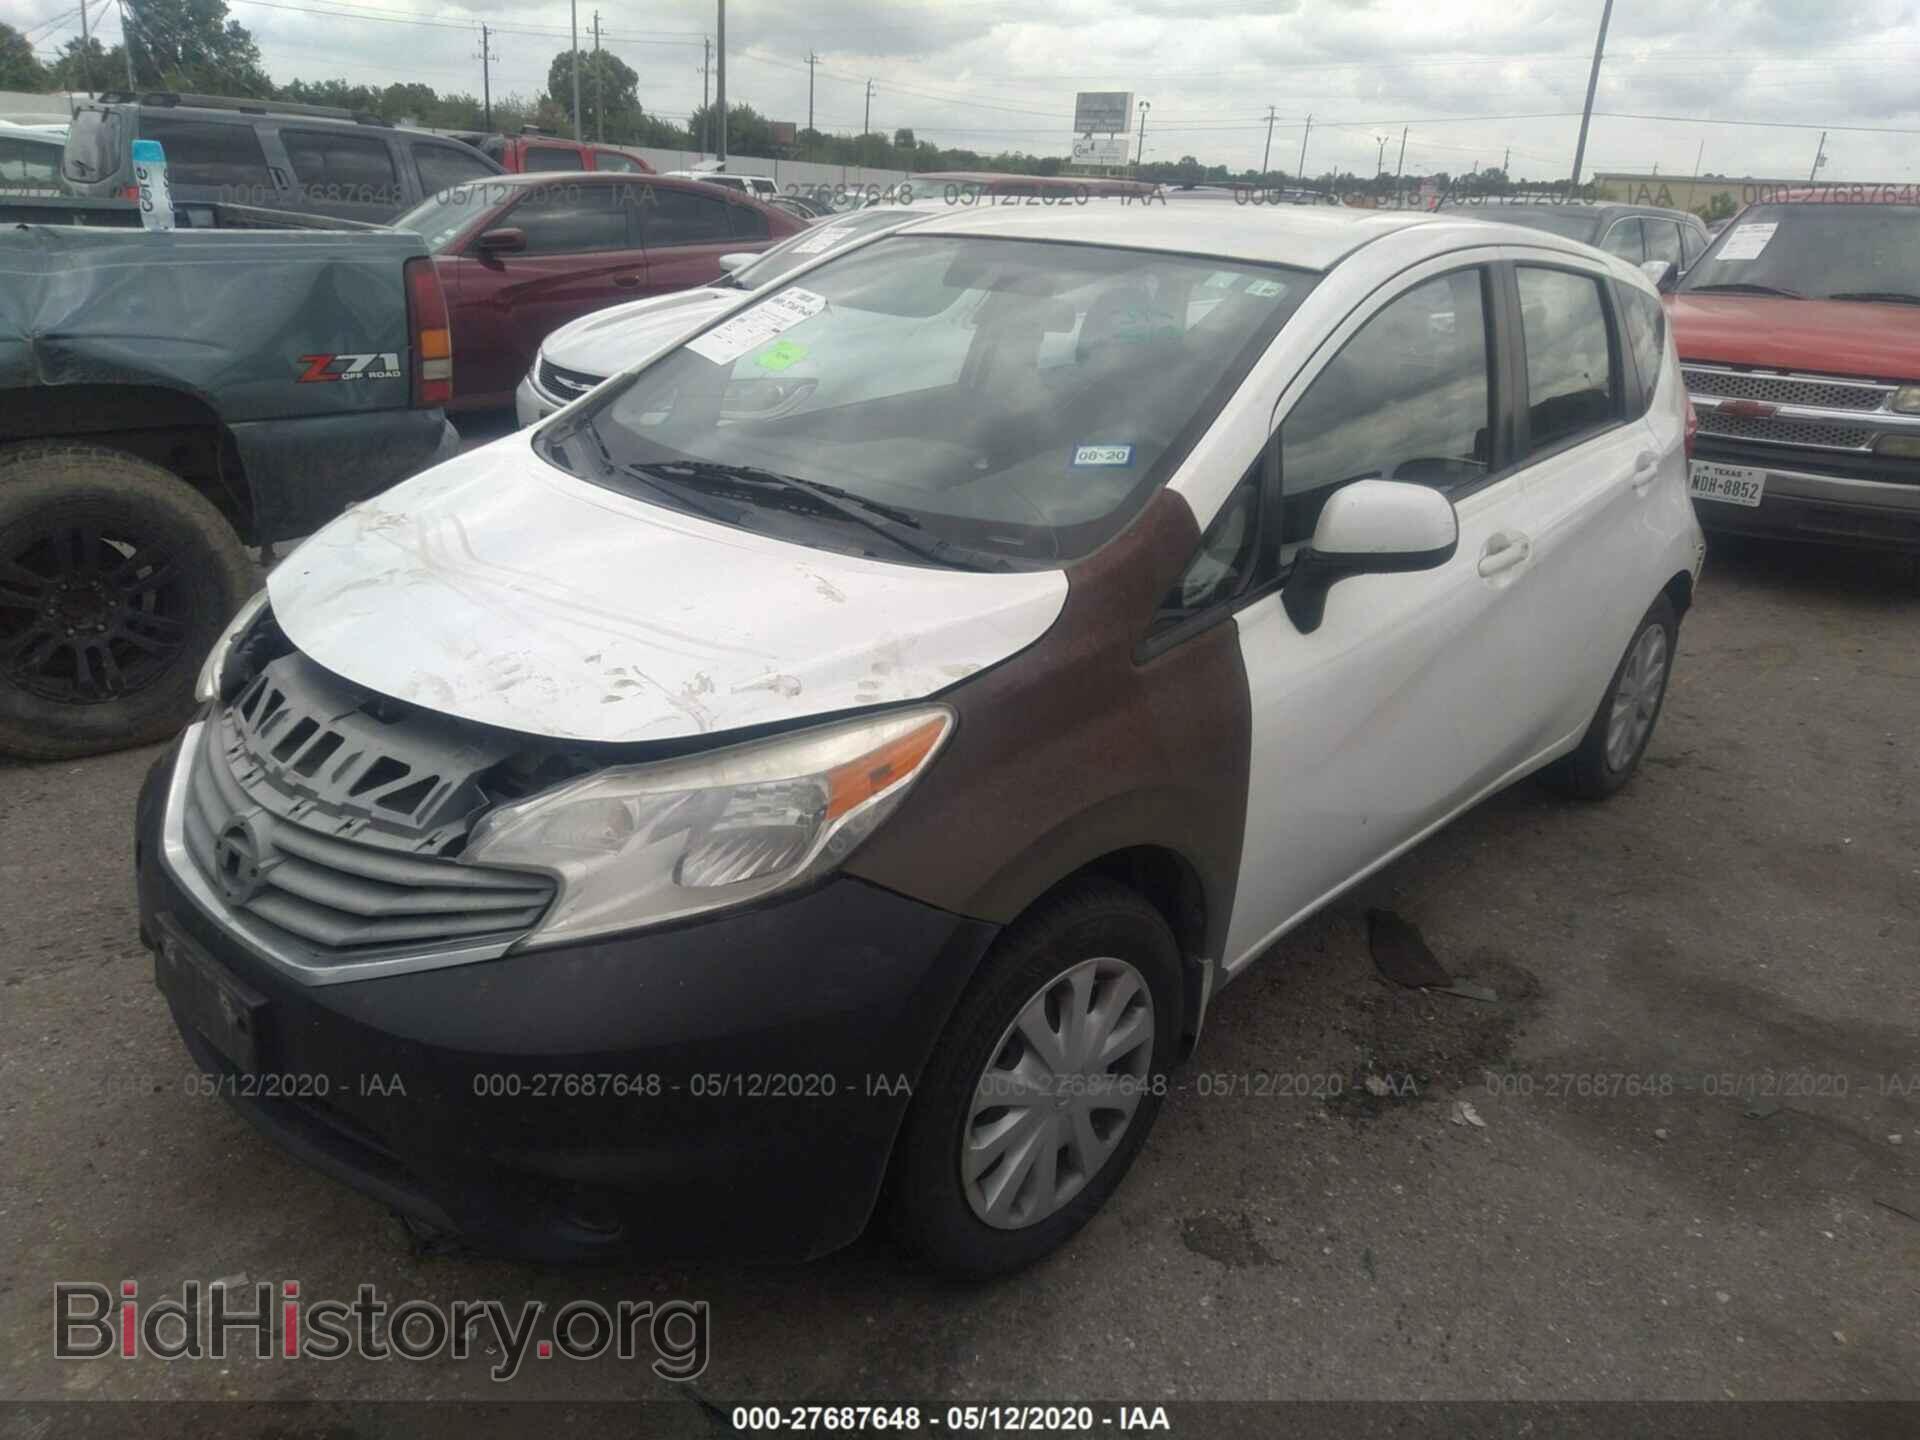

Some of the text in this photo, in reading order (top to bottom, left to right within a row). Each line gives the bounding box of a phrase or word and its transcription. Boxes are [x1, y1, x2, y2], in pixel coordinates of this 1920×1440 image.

[297, 352, 400, 383] Z71
[341, 370, 401, 380] OFF ROAD
[1714, 467, 1743, 477] TEXAS
